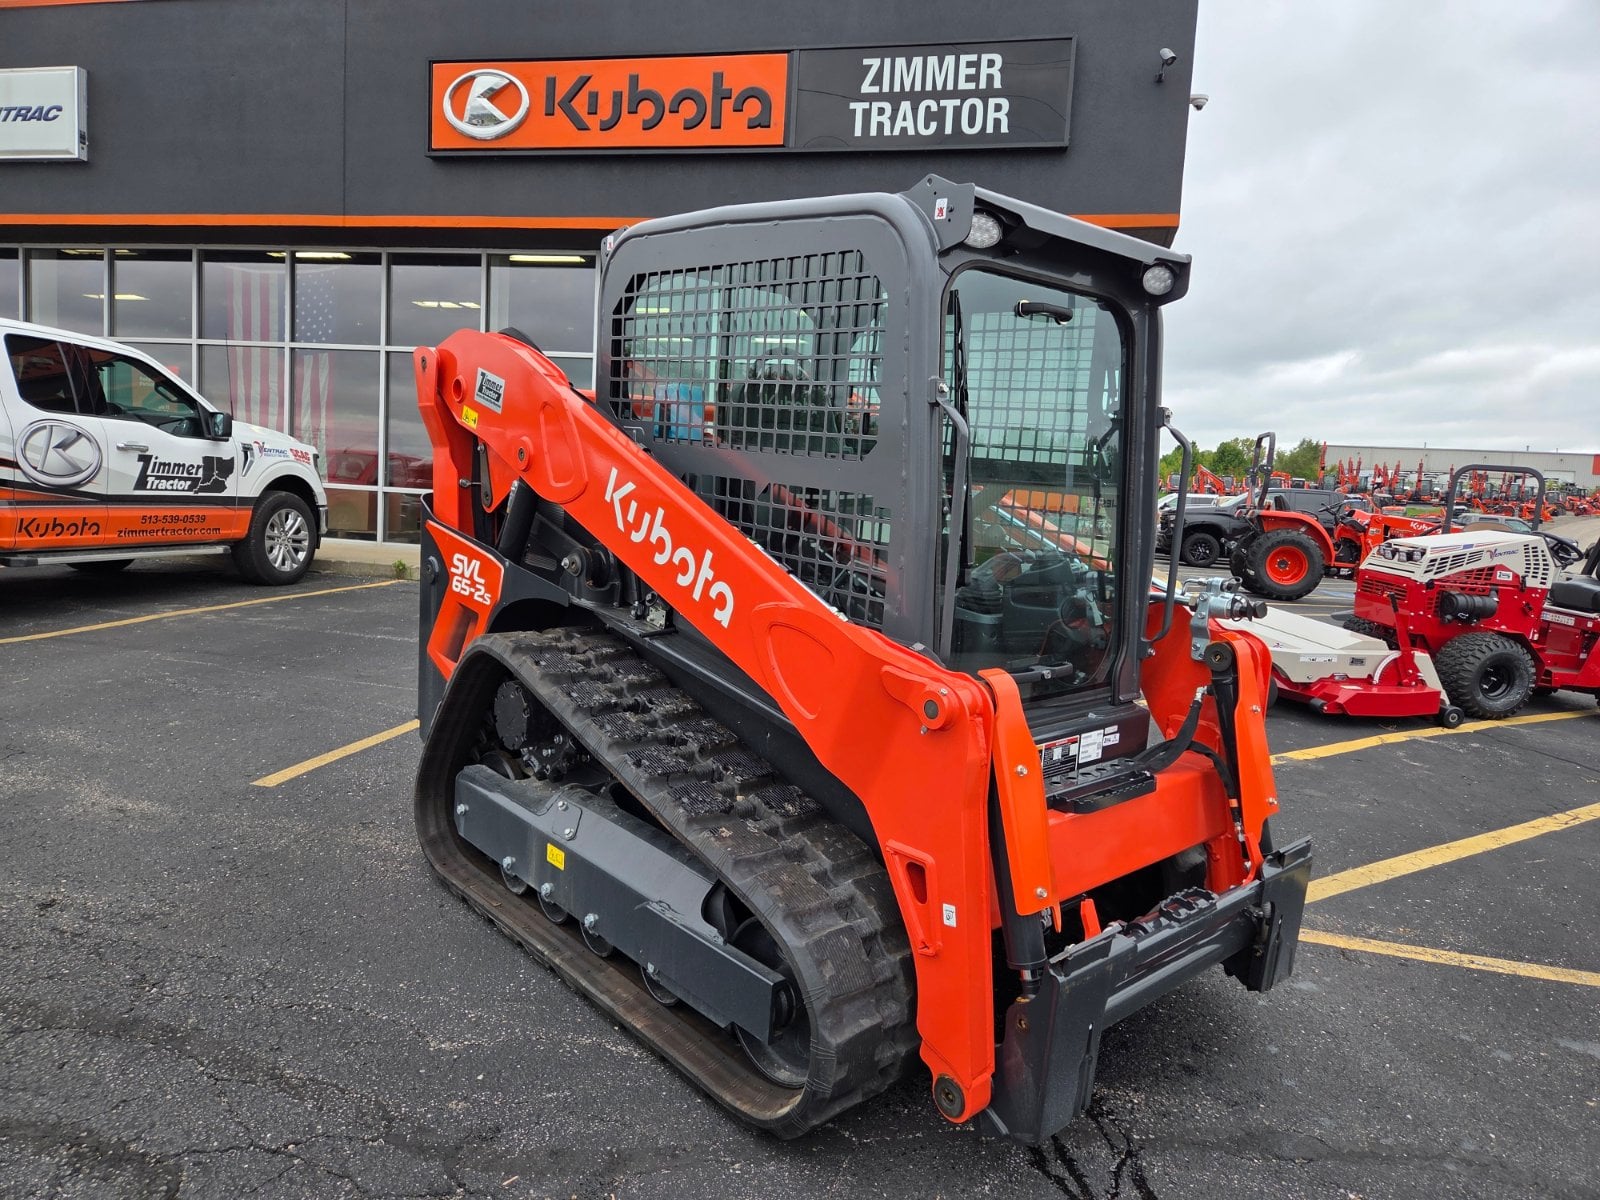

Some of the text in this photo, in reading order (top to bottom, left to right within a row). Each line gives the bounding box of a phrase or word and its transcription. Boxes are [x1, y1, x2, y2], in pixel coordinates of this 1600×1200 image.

[860, 53, 1003, 94] ZIMMER
[0, 105, 63, 122] TRAC
[544, 71, 772, 131] Kubota
[849, 97, 1010, 137] TRACTOR
[132, 454, 204, 482] Zimmer
[146, 476, 192, 490] Tractor
[17, 516, 101, 538] Kubota
[117, 526, 221, 538] zimmertractor.com
[140, 514, 206, 525] 513-539-0539
[604, 466, 734, 629] Kubota
[450, 552, 486, 584] SVL
